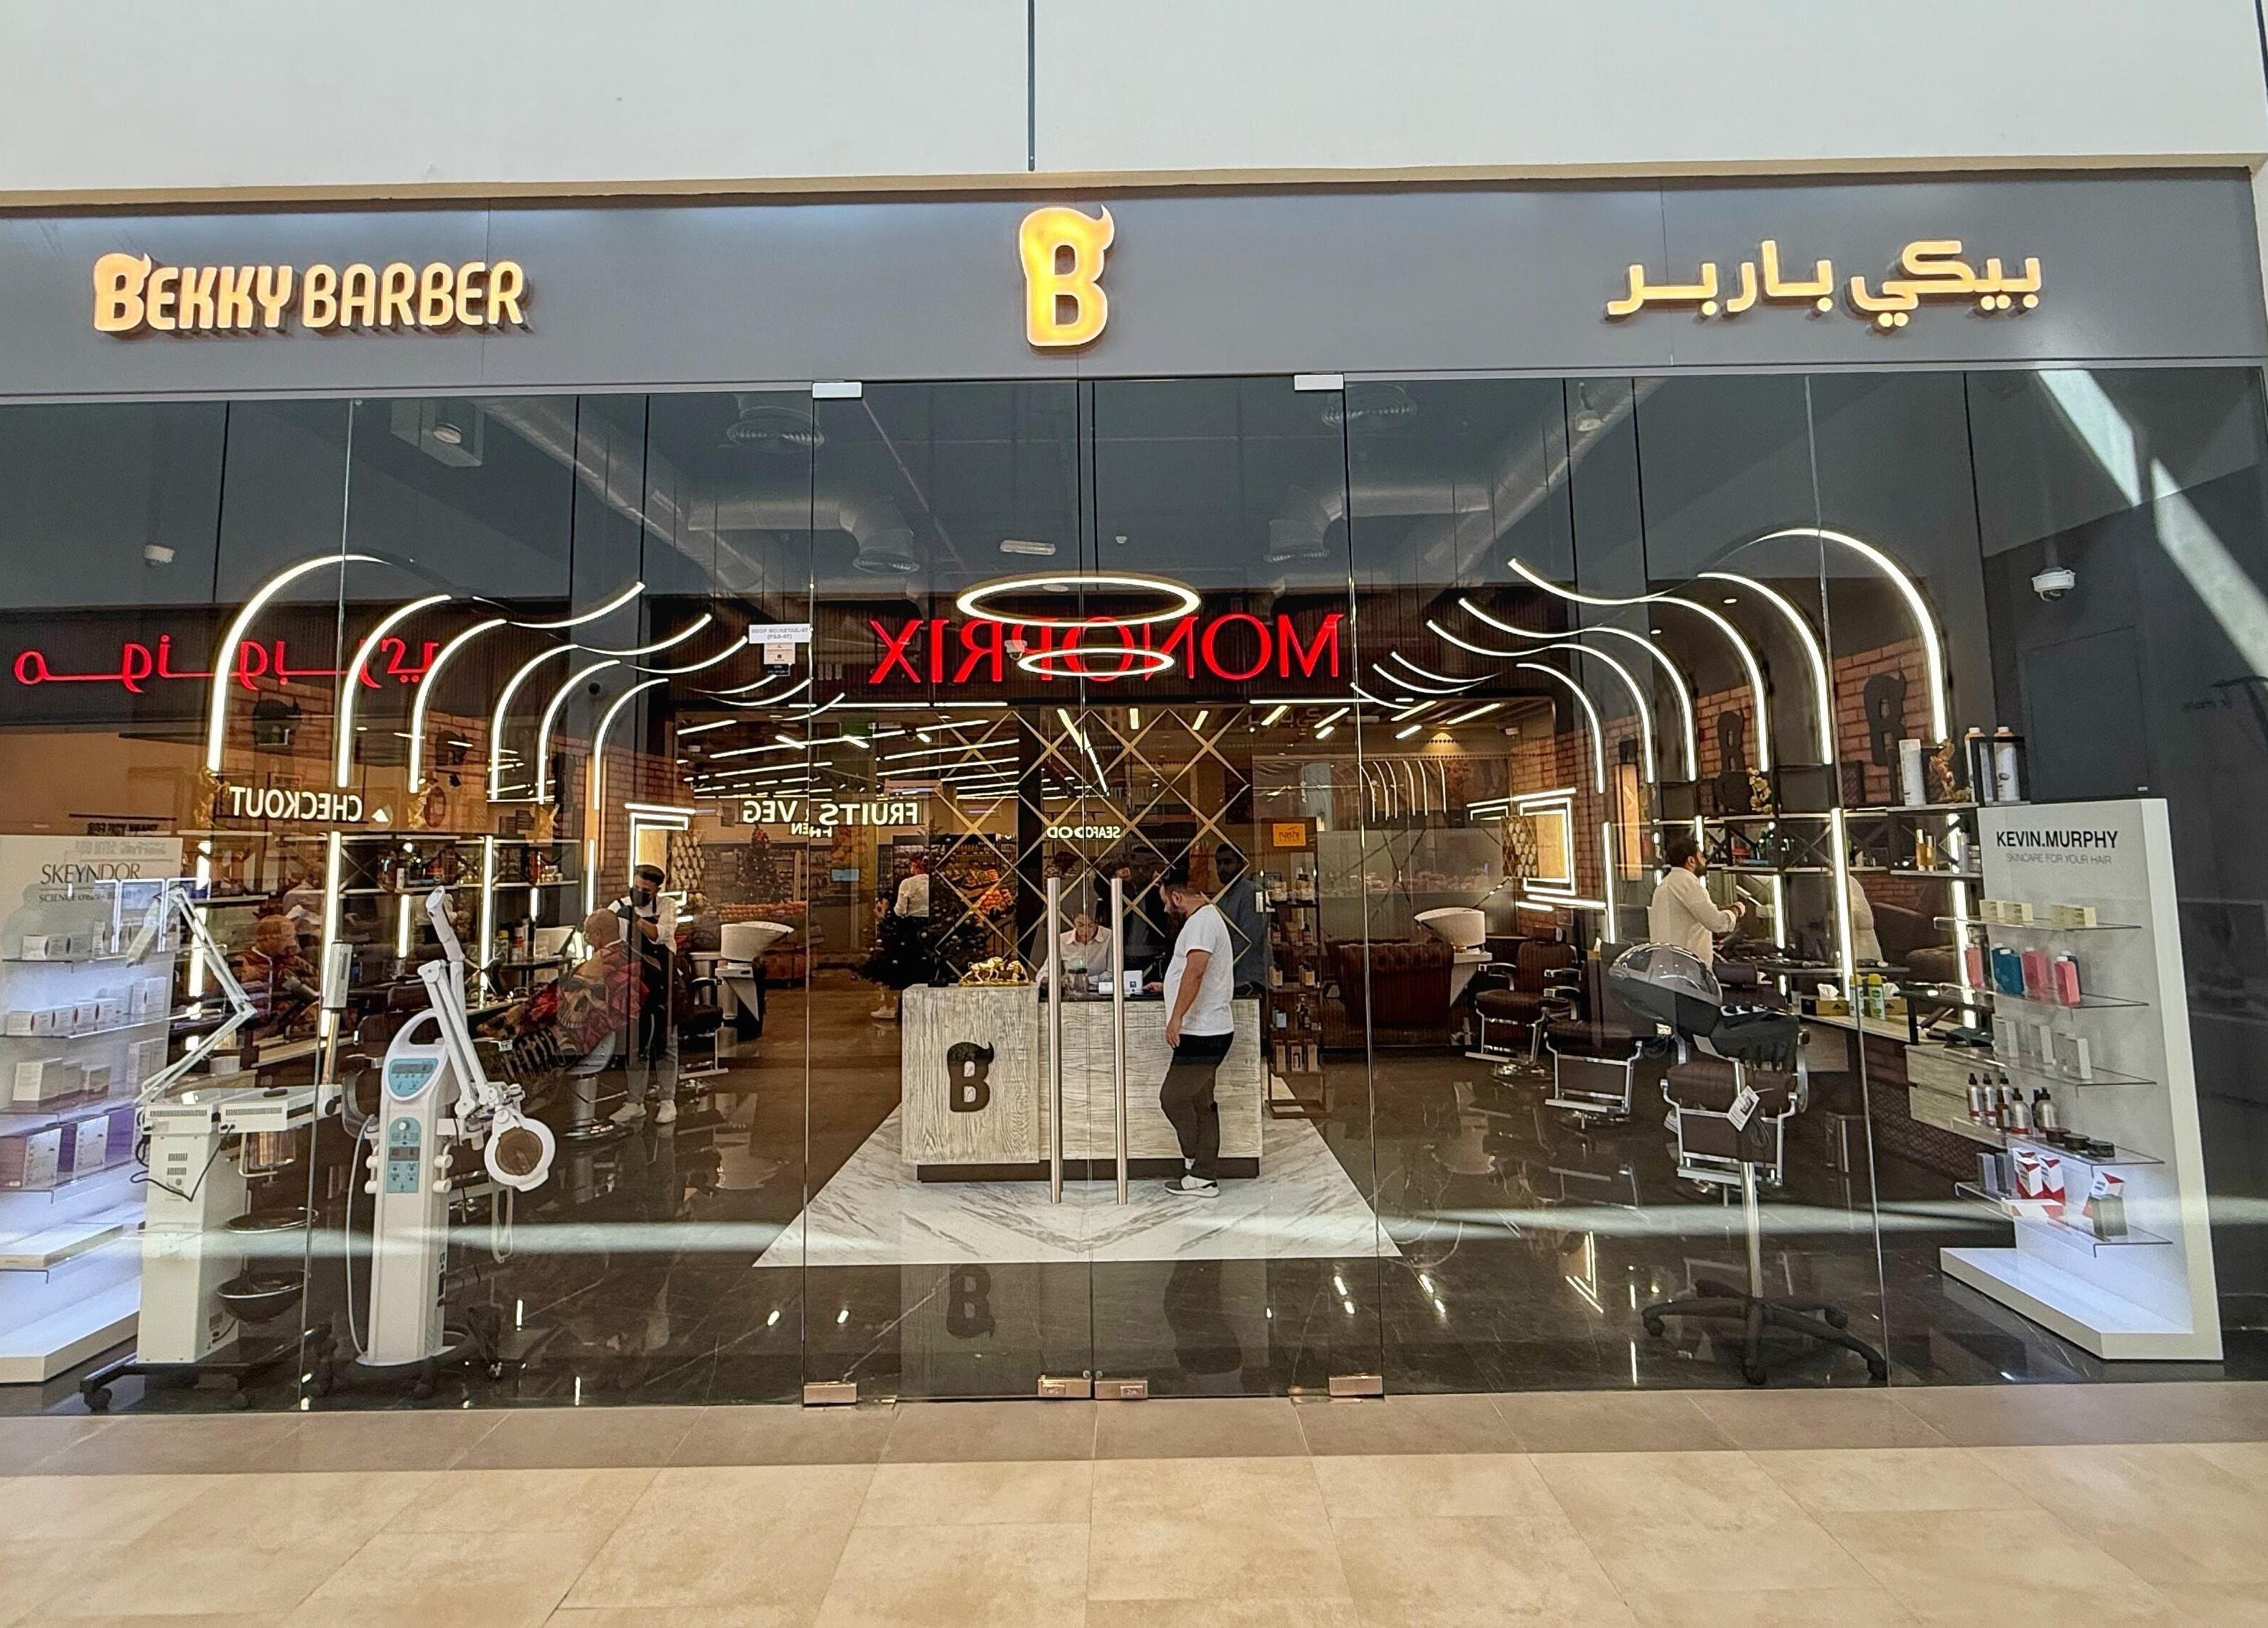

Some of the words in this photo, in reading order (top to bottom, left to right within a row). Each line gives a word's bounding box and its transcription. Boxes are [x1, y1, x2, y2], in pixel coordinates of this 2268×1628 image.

[93, 253, 294, 332] BEKKY
[302, 261, 525, 328] BARBER
[1019, 204, 1115, 347] B
[1849, 240, 2041, 327] بيكي
[40, 862, 141, 885] SKEYNDOR
[1995, 829, 2119, 849] KEVIN.MURPHY
[2045, 853, 2063, 864] FOR
[2065, 854, 2089, 865] YOUR
[2090, 855, 2112, 865] HAIR
[946, 1041, 995, 1113] B
